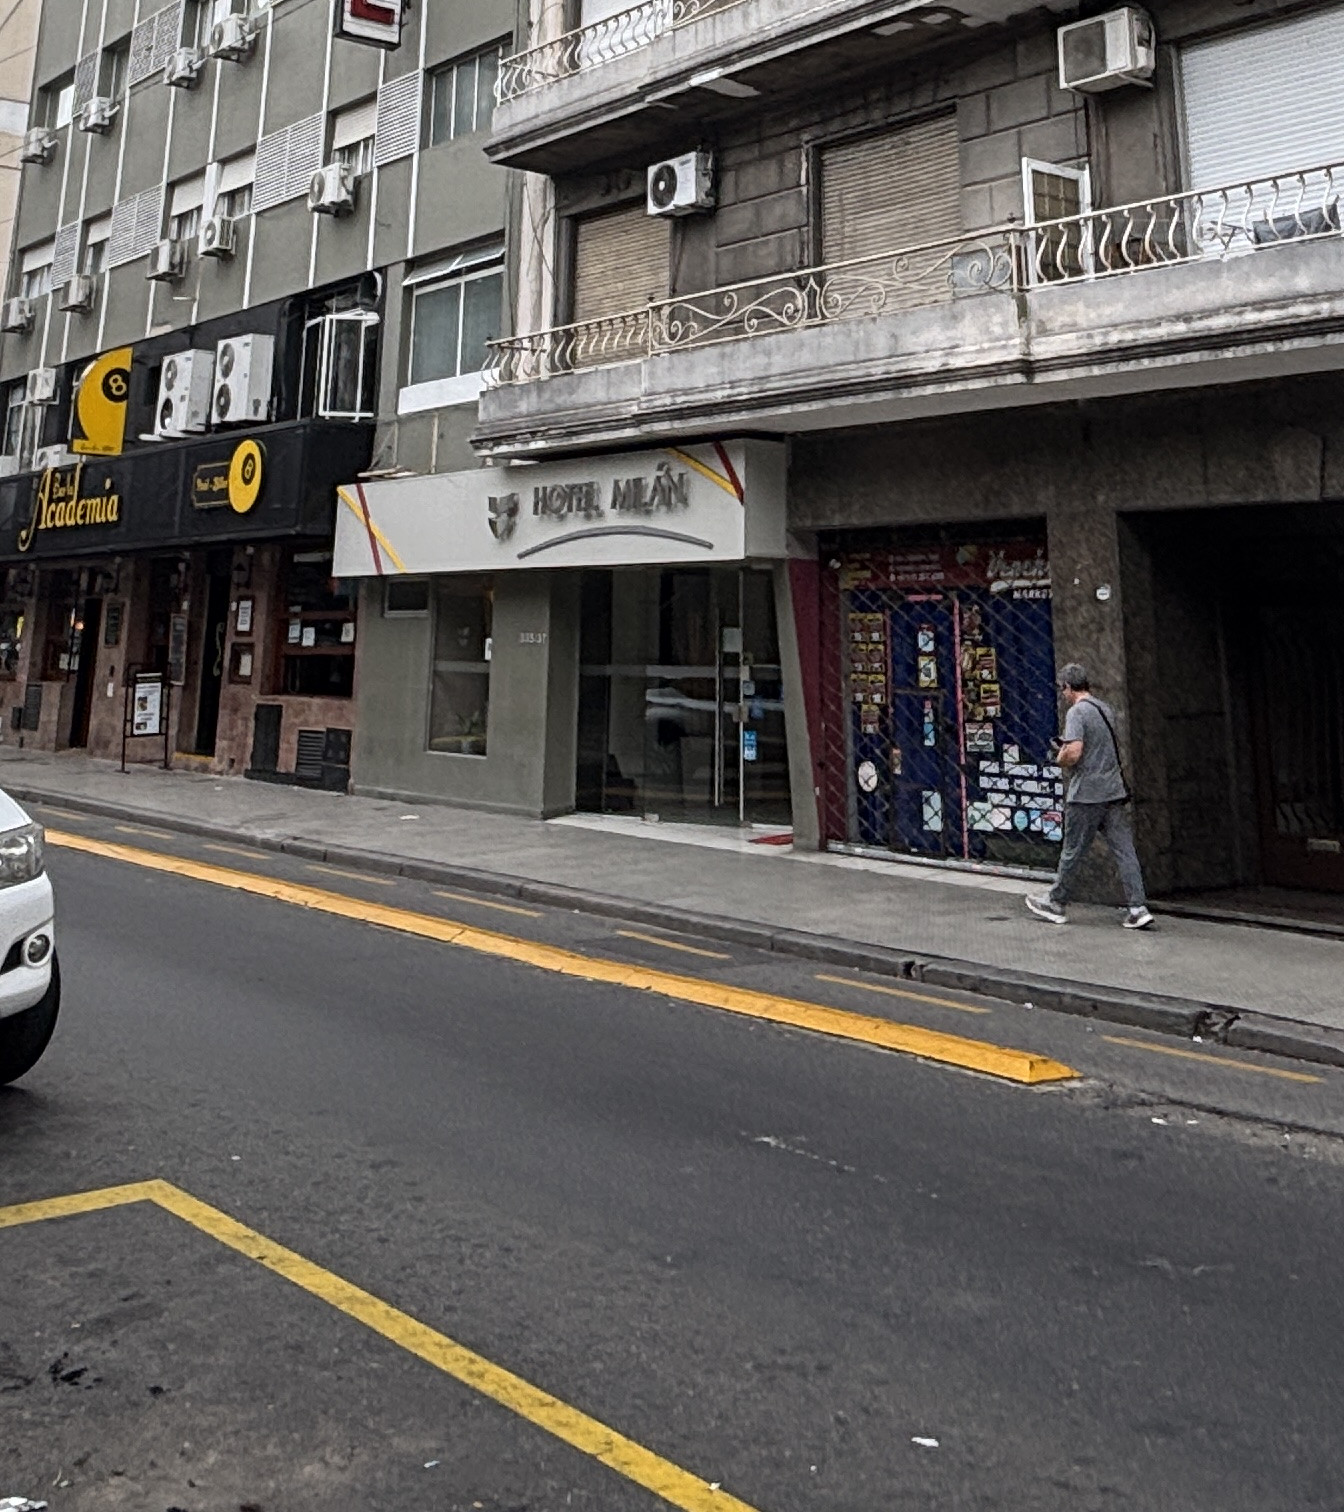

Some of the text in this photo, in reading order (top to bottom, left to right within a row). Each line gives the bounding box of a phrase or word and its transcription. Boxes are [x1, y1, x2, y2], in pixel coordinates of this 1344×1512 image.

[109, 374, 127, 396] 8
[18, 461, 119, 552] Academia
[532, 462, 690, 516] HOTEL MILÁN
